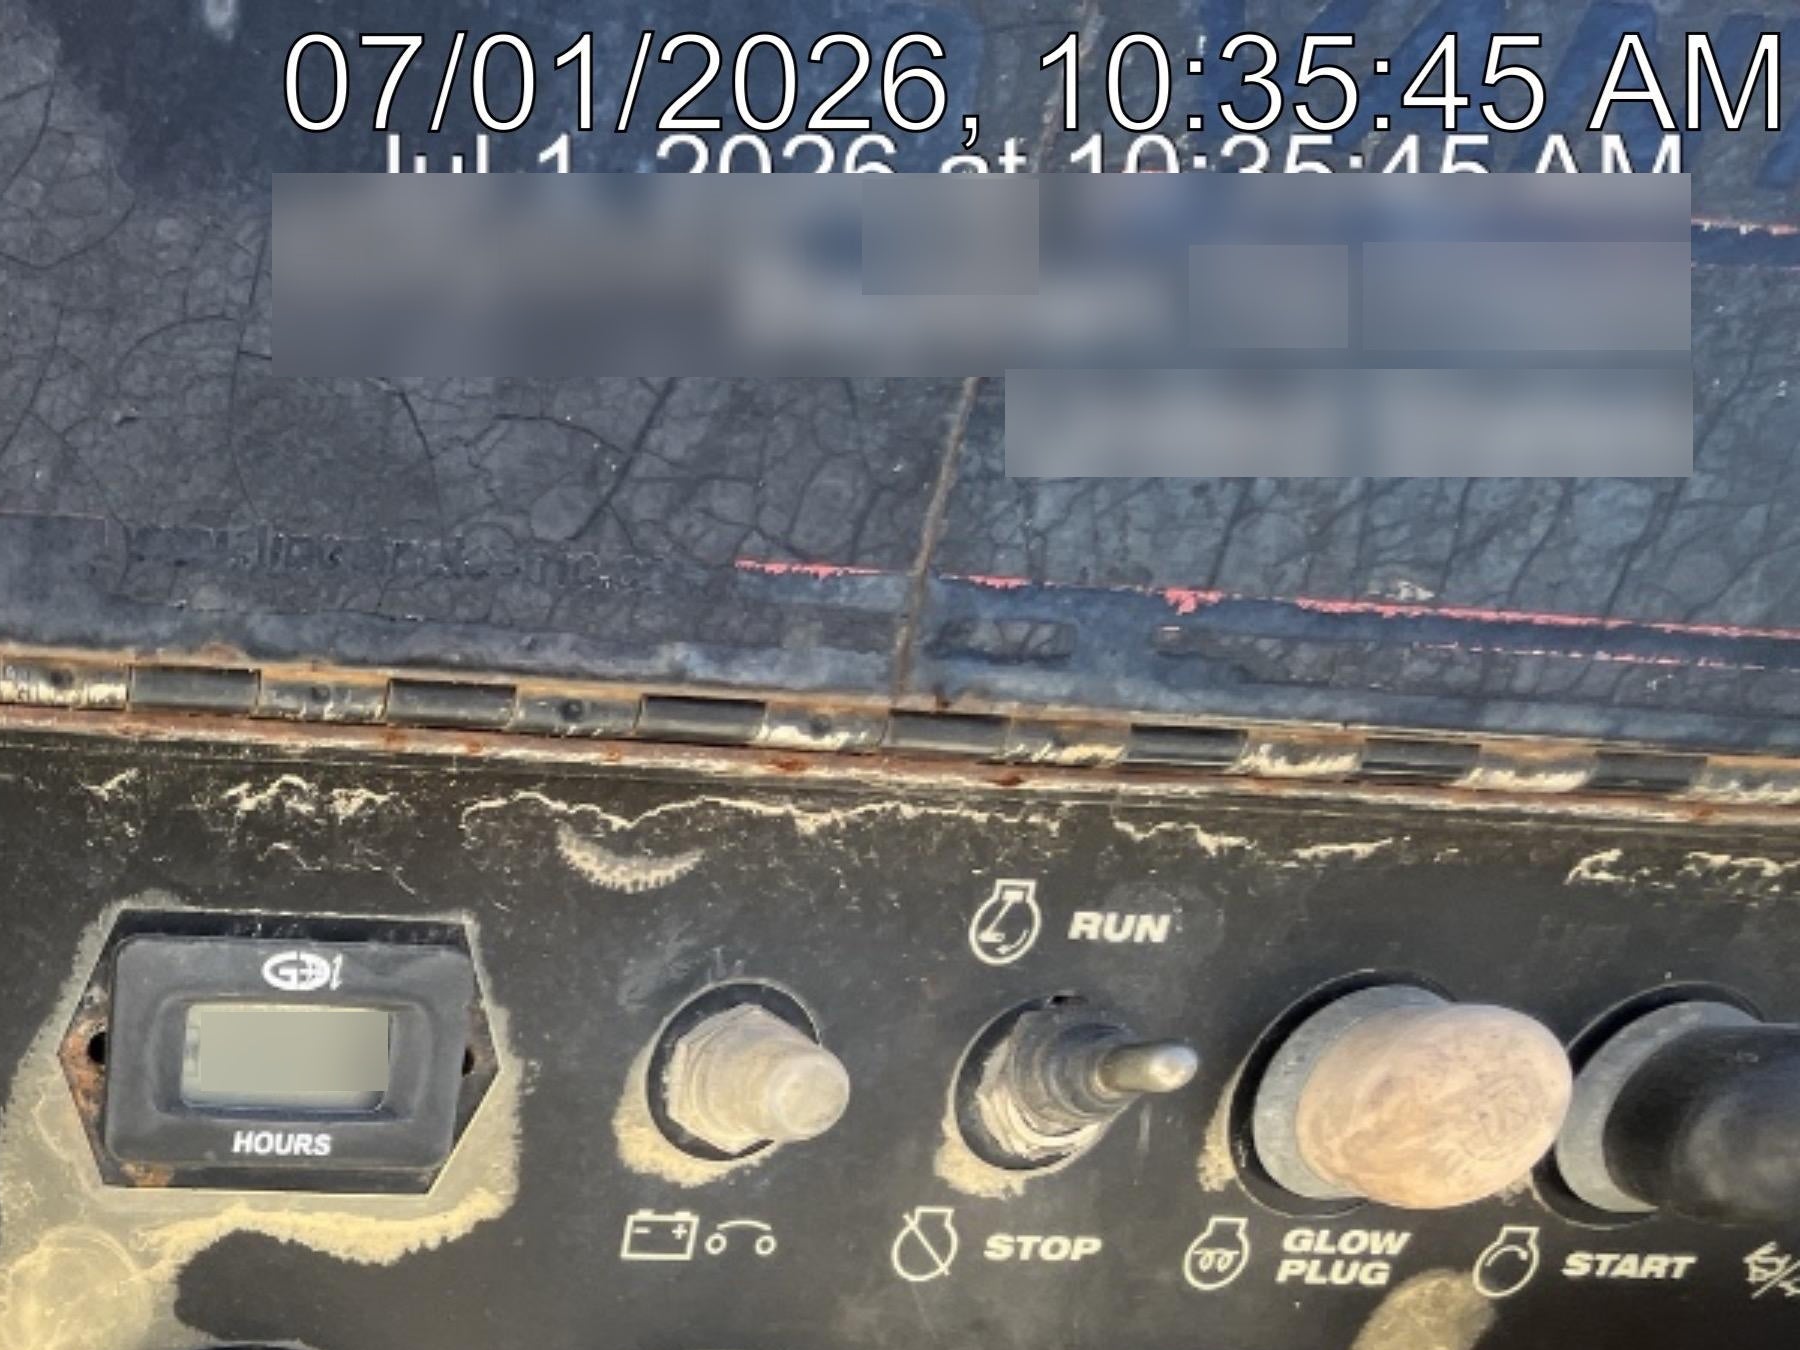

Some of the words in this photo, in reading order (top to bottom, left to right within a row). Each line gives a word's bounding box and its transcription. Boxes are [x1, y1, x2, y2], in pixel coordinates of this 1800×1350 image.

[1067, 910, 1170, 943] RUN
[232, 1130, 332, 1157] HOURS
[982, 1231, 1103, 1262] STOP
[1280, 1226, 1411, 1256] GLOW
[1274, 1258, 1392, 1287] PLUG
[1560, 1251, 1697, 1280] START
